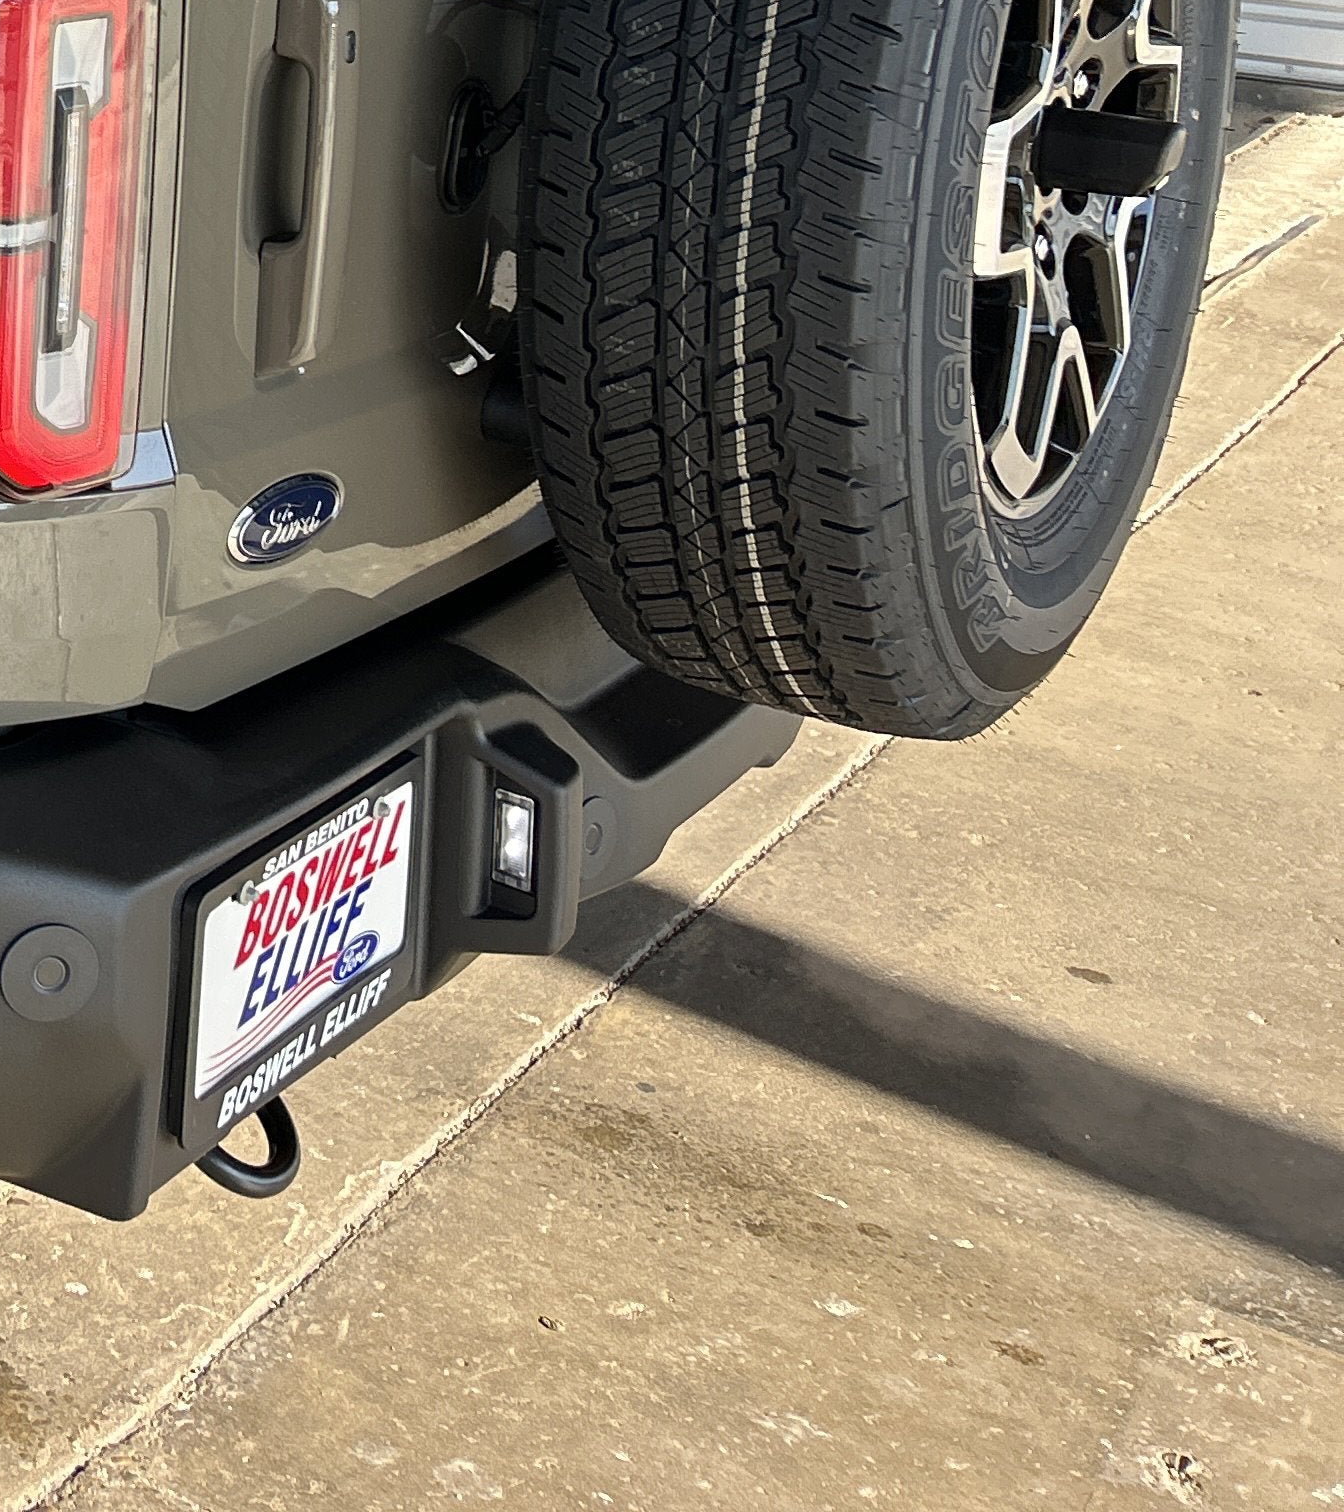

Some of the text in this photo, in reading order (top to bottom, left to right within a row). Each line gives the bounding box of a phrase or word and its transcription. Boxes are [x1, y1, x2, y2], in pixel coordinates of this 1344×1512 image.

[233, 800, 406, 971] BOSWELL
[262, 797, 371, 880] SAN BENITO
[237, 876, 374, 1030] ELLIFF
[217, 968, 392, 1129] BOSWELL ELLIFF
